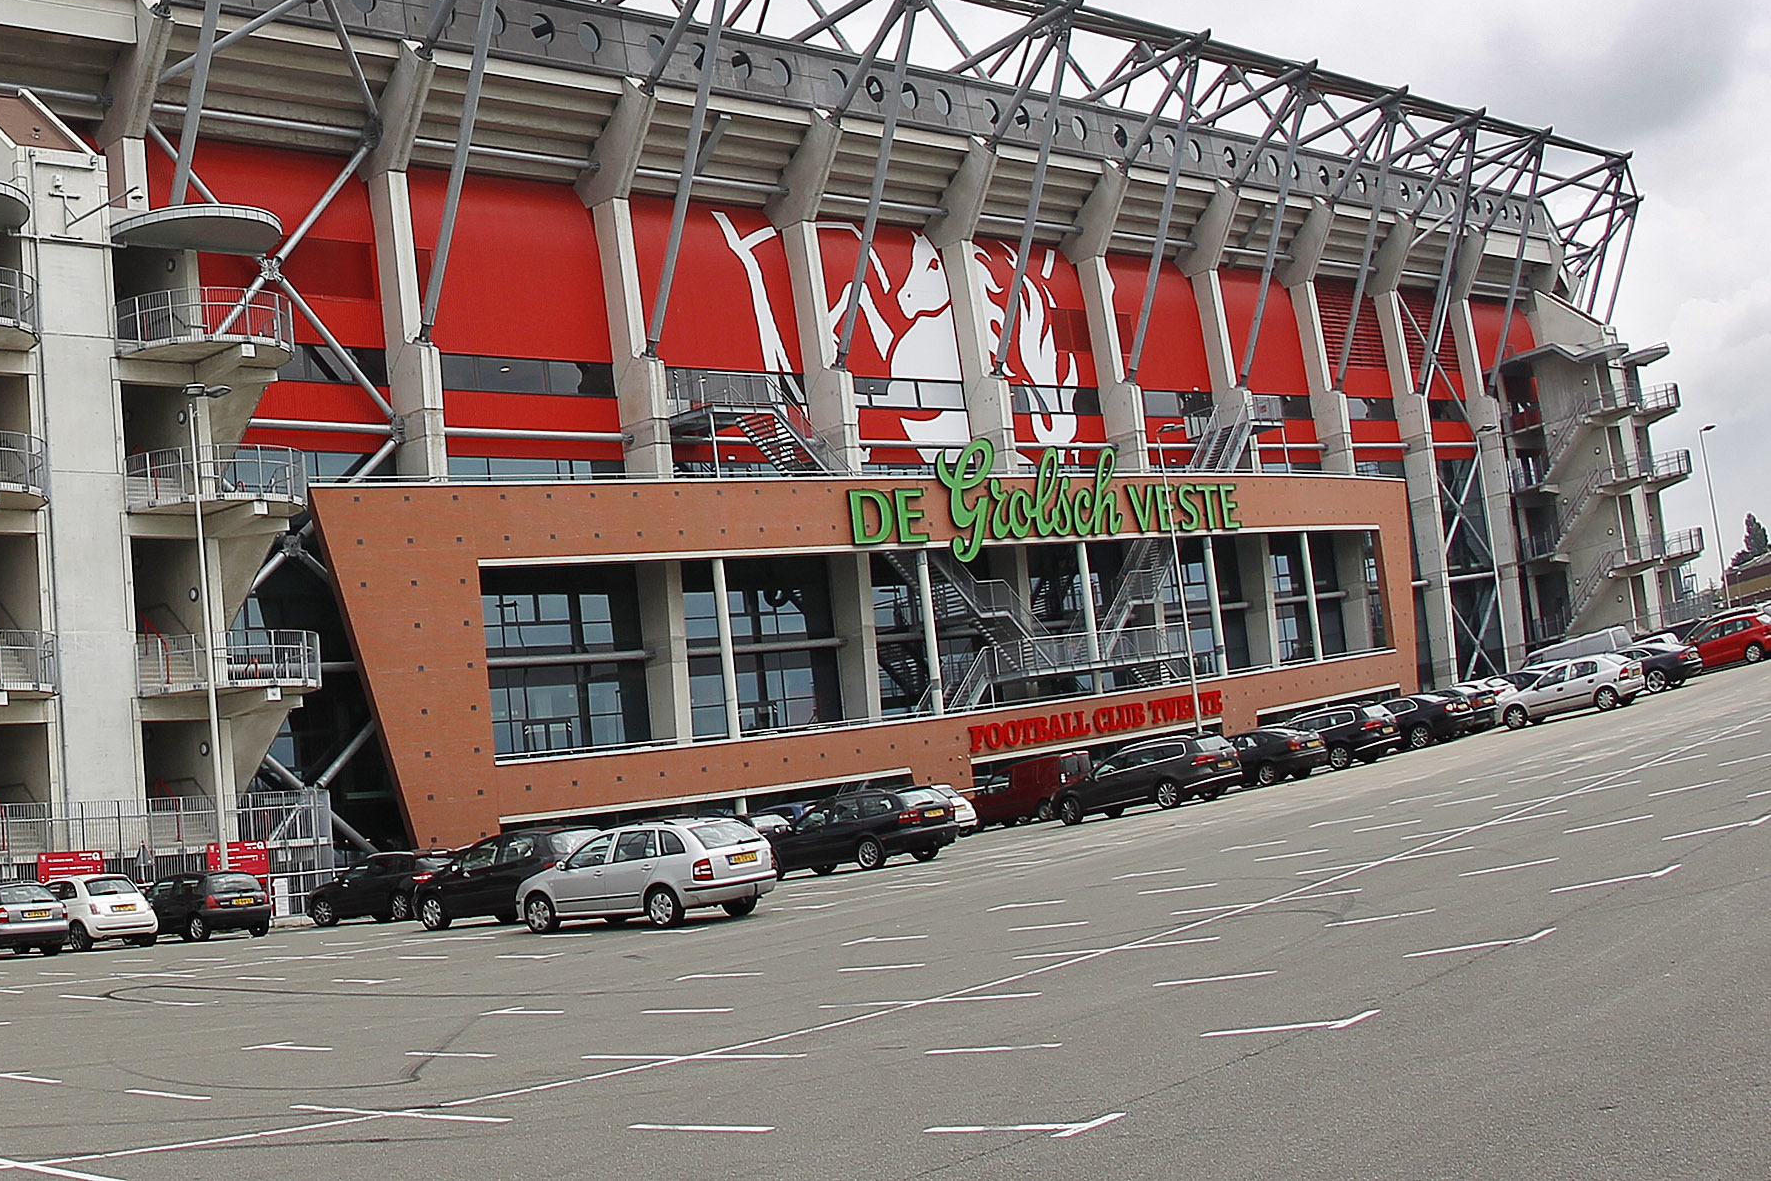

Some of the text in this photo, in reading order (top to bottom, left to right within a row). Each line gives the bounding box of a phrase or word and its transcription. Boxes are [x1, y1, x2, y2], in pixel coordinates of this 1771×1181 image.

[848, 437, 1243, 562] DE Grolsch VESTE
[967, 710, 1092, 753] FOOTBALL
[1092, 702, 1147, 733] CLUB
